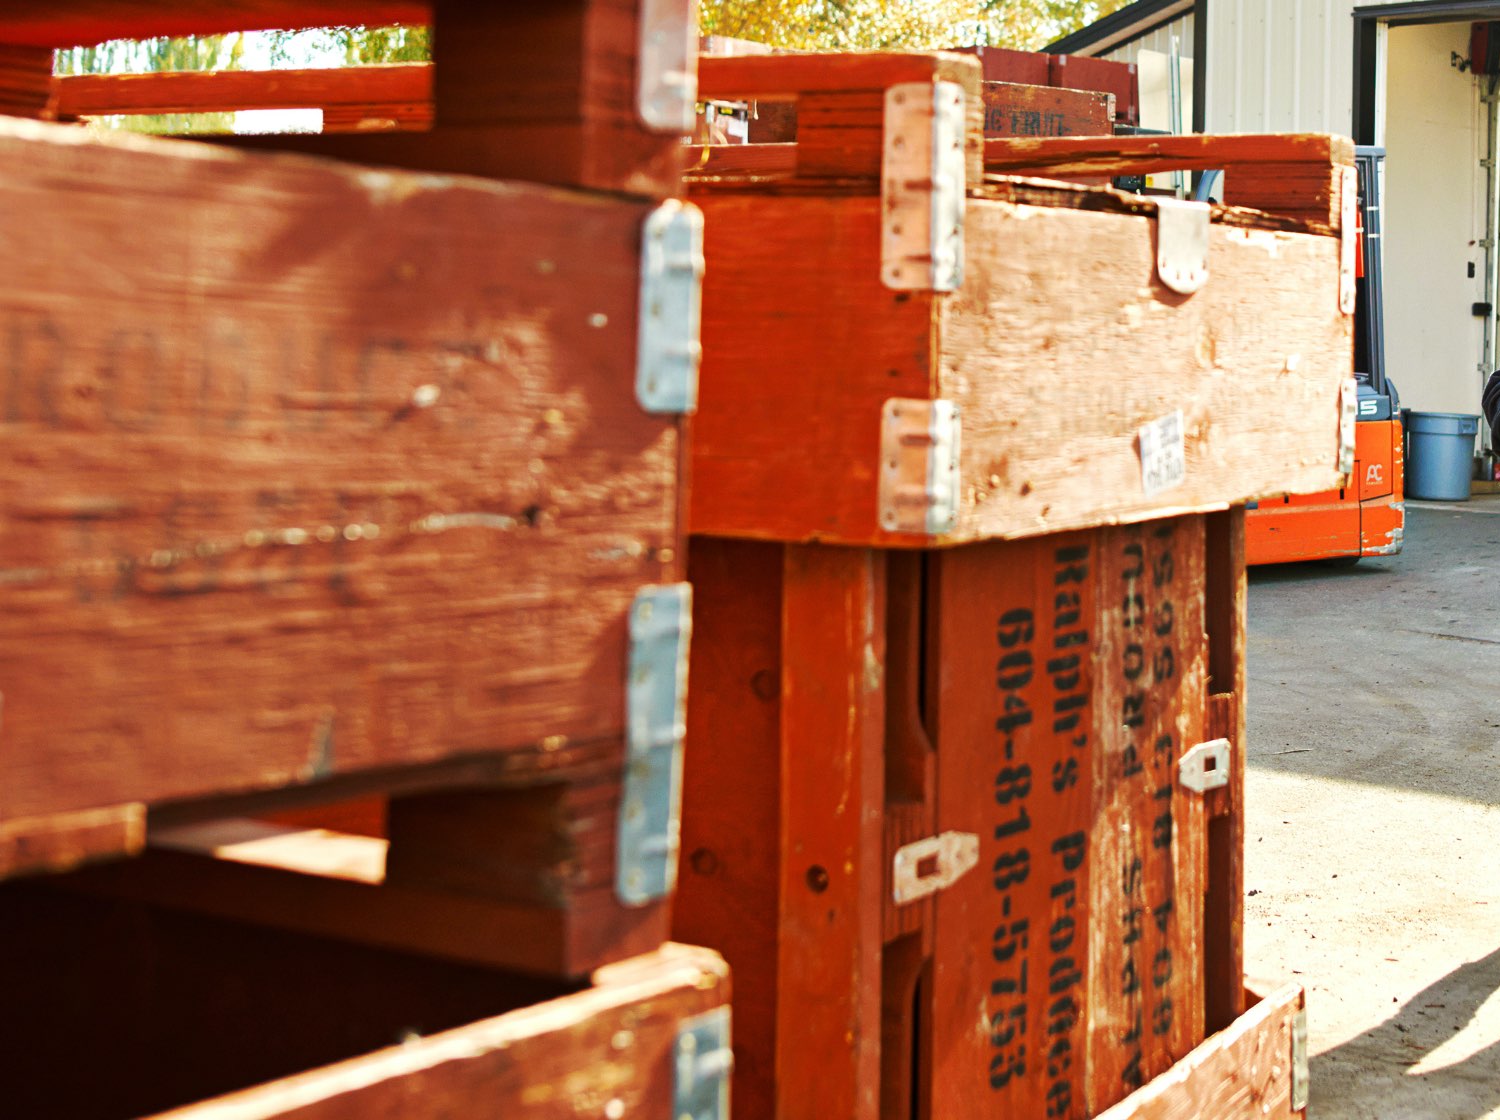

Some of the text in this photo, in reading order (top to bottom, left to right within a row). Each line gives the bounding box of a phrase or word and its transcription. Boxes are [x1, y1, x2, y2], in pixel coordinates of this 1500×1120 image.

[989, 607, 1035, 1091] 604-818-5753
[1046, 544, 1091, 1118] Ralph's Produce
[1152, 902, 1174, 1036] 604
